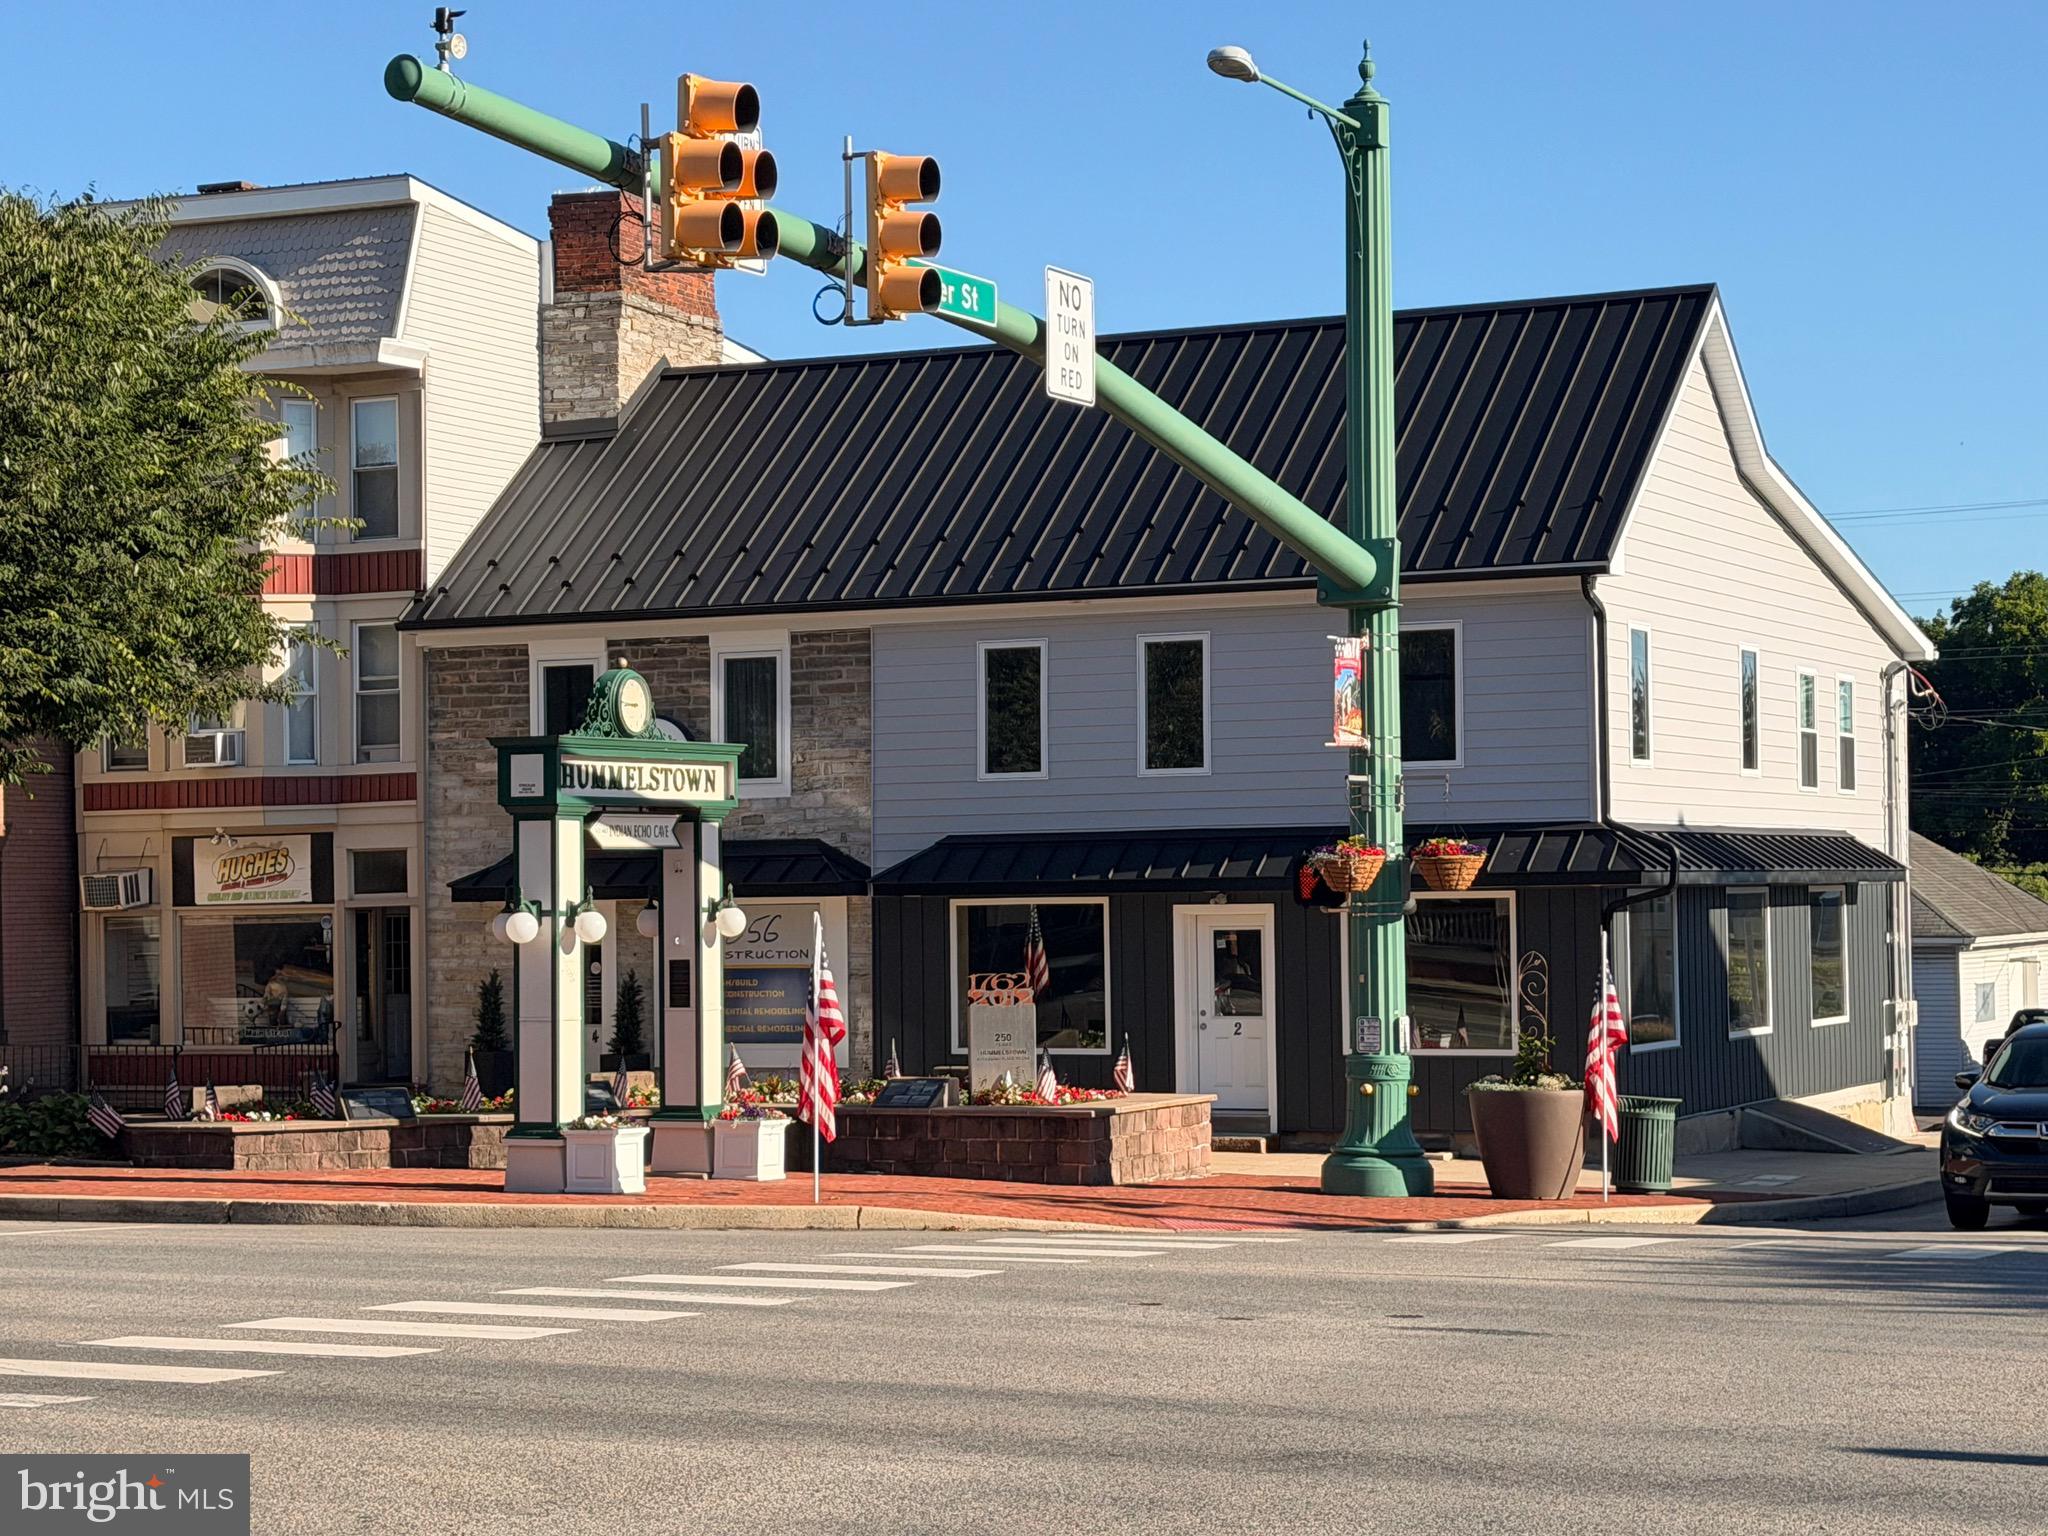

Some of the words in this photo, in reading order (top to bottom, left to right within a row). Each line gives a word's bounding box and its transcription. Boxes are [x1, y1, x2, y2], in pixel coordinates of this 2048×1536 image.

[941, 283, 954, 304] er
[961, 283, 979, 312] St
[1059, 280, 1082, 312] NO
[1057, 314, 1086, 340] TURN
[1064, 342, 1079, 364] ON
[1061, 367, 1083, 390] RED
[560, 763, 717, 793] HUMMELSTOWN
[609, 824, 632, 838] INDIAN
[634, 824, 652, 839] ECHO
[653, 825, 670, 838] CAVE
[216, 847, 290, 885] HUGHES
[725, 914, 782, 945] 56
[724, 949, 809, 960] STRUCTION
[725, 1007, 753, 1015] ENTIAL
[725, 1024, 755, 1033] ERCIAL
[757, 1024, 804, 1033] REMODELIN
[994, 1033, 1012, 1042] 250
[1233, 1021, 1243, 1036] 2
